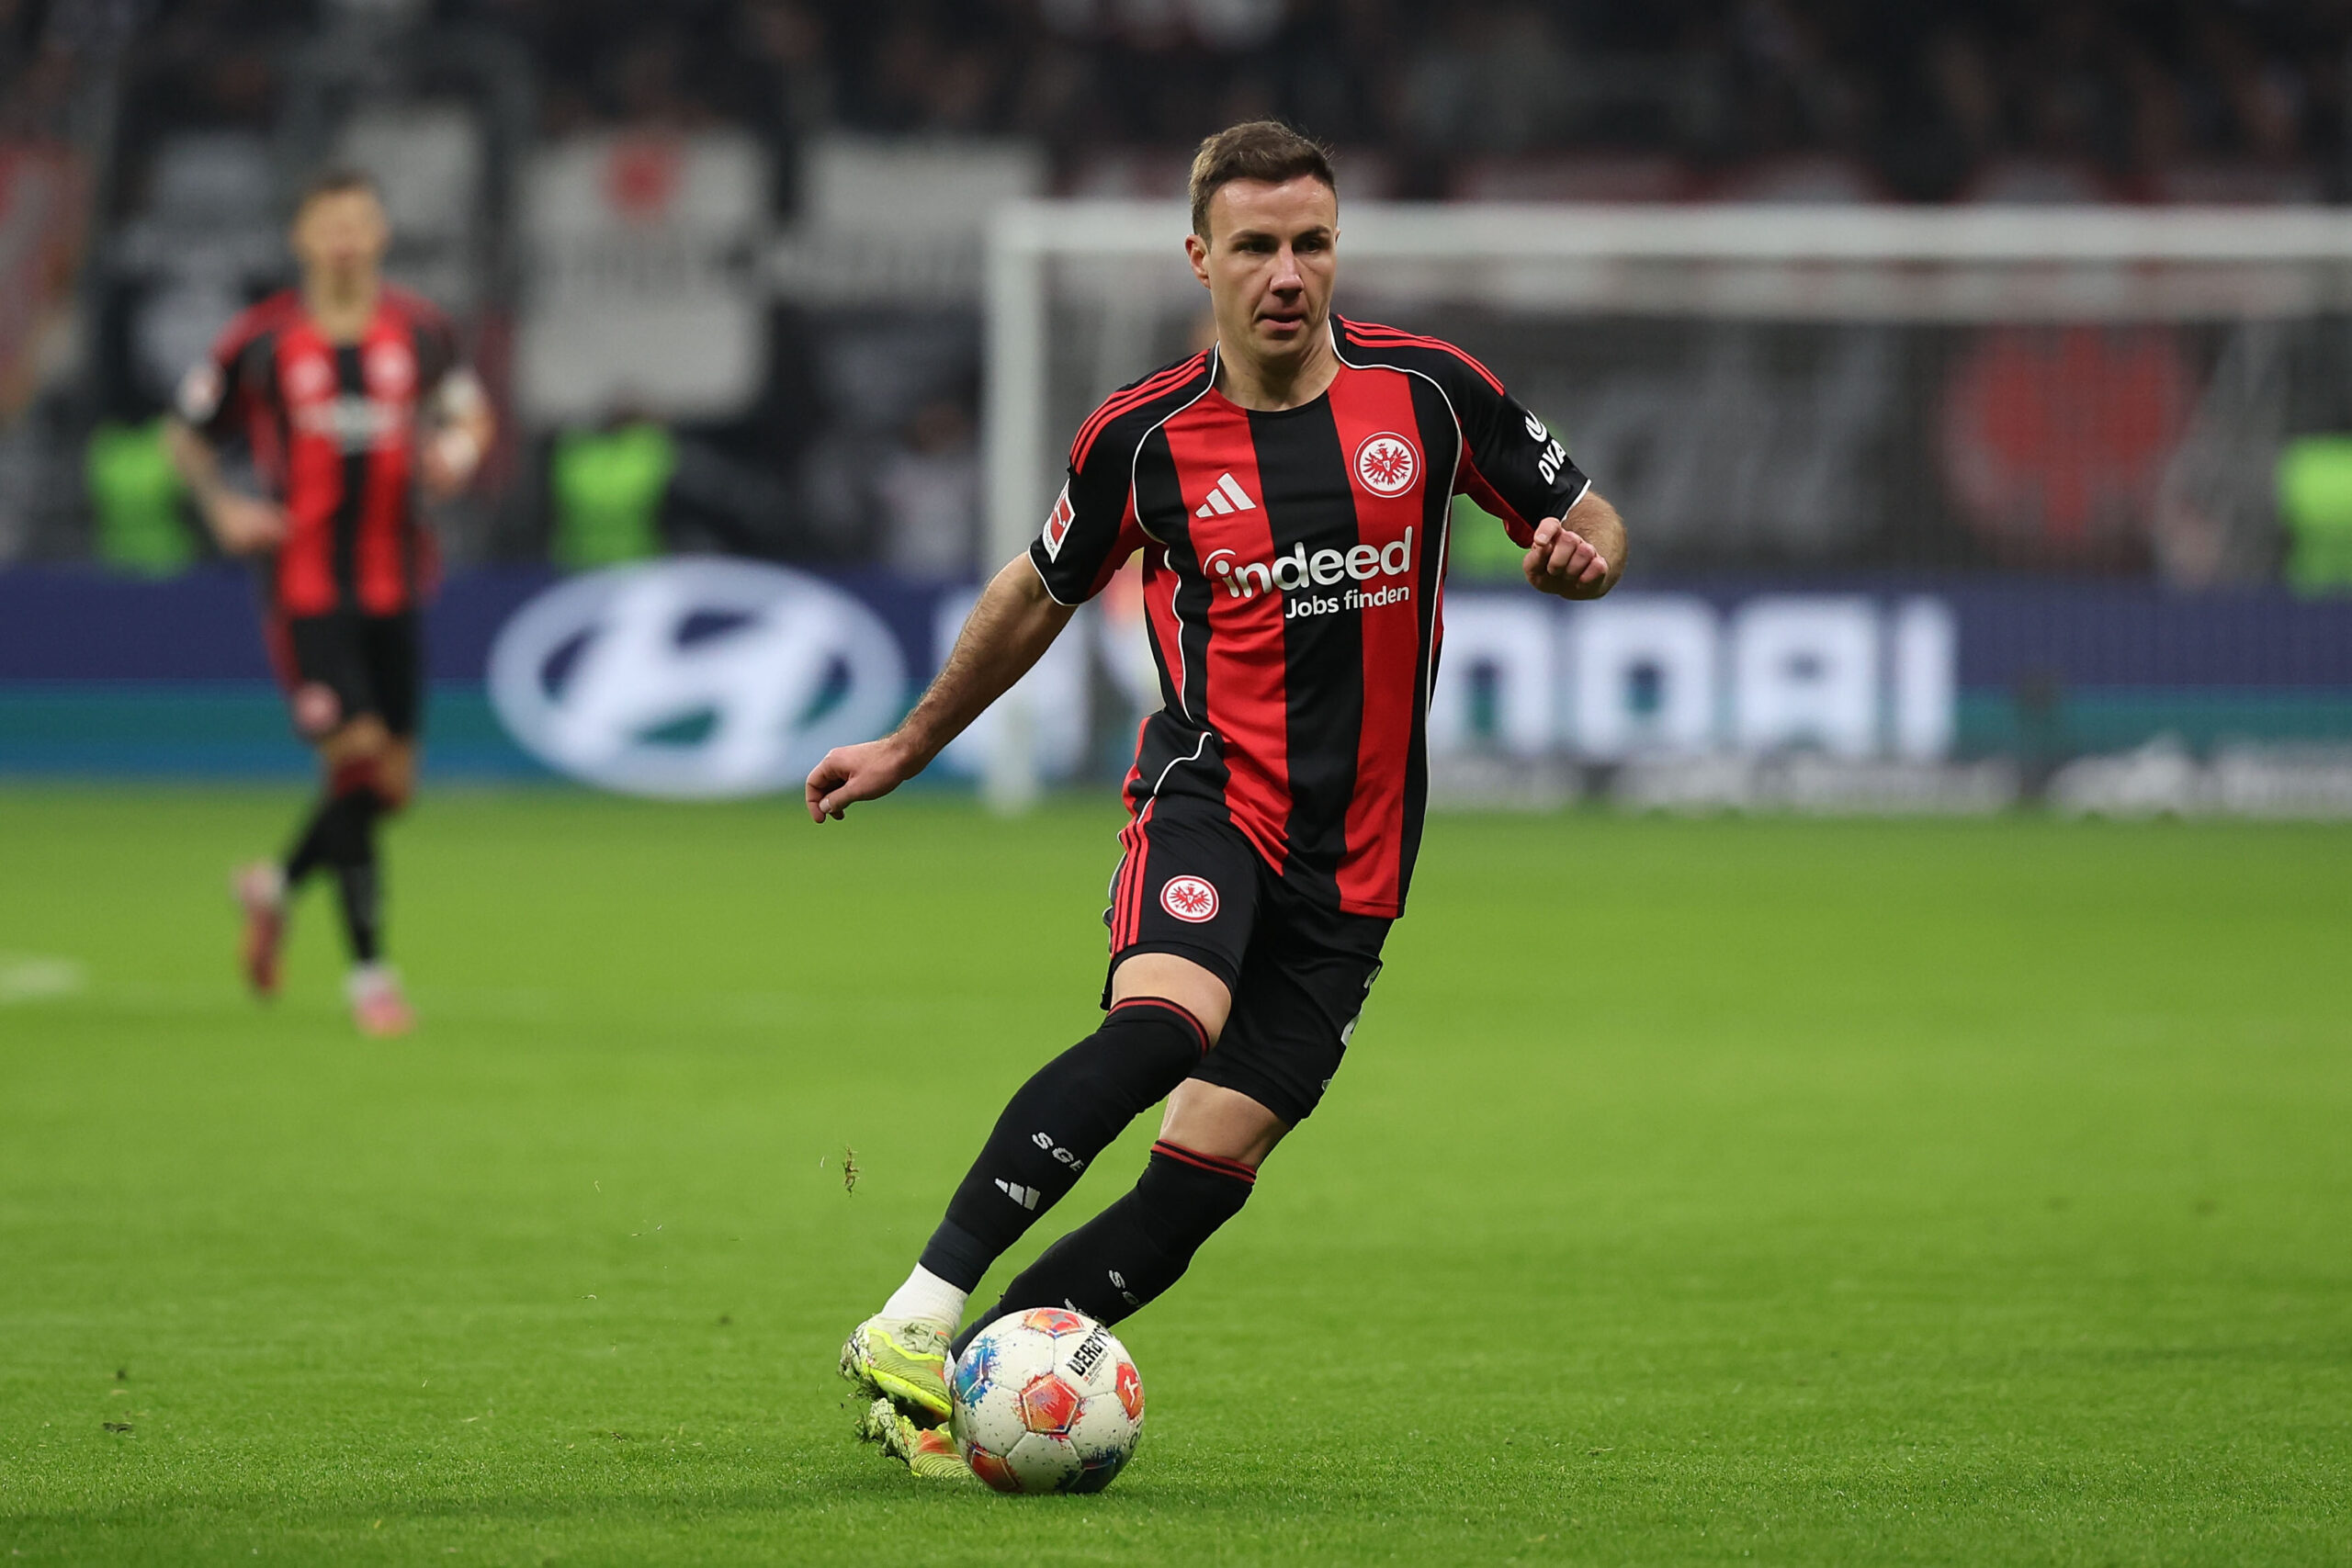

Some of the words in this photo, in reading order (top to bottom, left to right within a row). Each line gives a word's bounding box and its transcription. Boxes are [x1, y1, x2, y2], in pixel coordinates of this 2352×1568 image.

[1204, 525, 1413, 597] indeed
[1284, 595, 1340, 619] Jobs
[1343, 585, 1410, 610] finden
[1031, 1131, 1085, 1172] SGE
